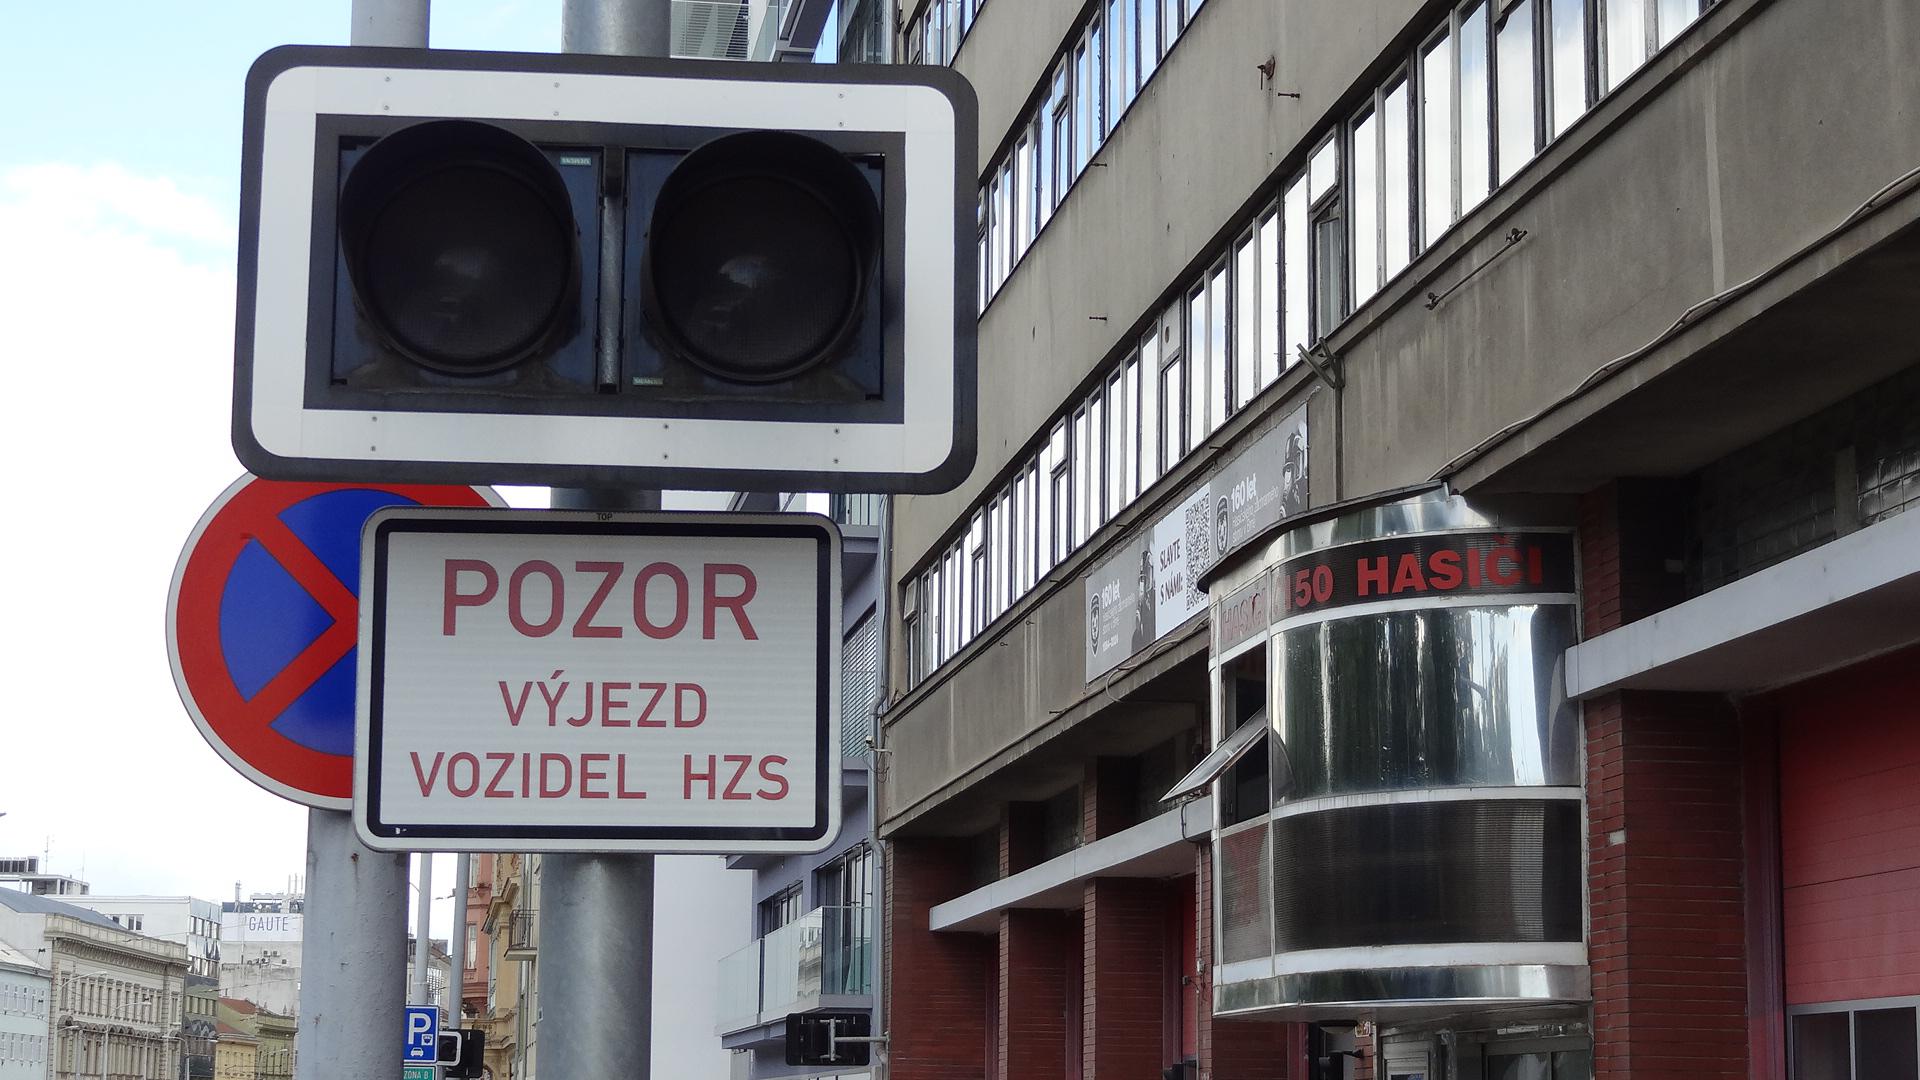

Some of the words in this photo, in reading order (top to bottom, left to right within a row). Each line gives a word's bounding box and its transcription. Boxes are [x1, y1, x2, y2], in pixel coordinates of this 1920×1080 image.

[1230, 480, 1246, 513] 160
[1246, 473, 1257, 502] let
[596, 512, 613, 521] TOP
[1159, 538, 1181, 572] SLAVTE
[1357, 533, 1543, 597] HASIČI
[443, 559, 759, 640] POZOR
[1101, 583, 1112, 609] 160
[1160, 584, 1165, 606] S
[499, 670, 707, 728] VÝJEZD
[410, 752, 647, 799] VOZIDEL
[684, 754, 790, 800] HZS
[249, 916, 289, 932] GAUTE
[408, 1012, 432, 1045] P
[403, 1070, 421, 1080] ZONA
